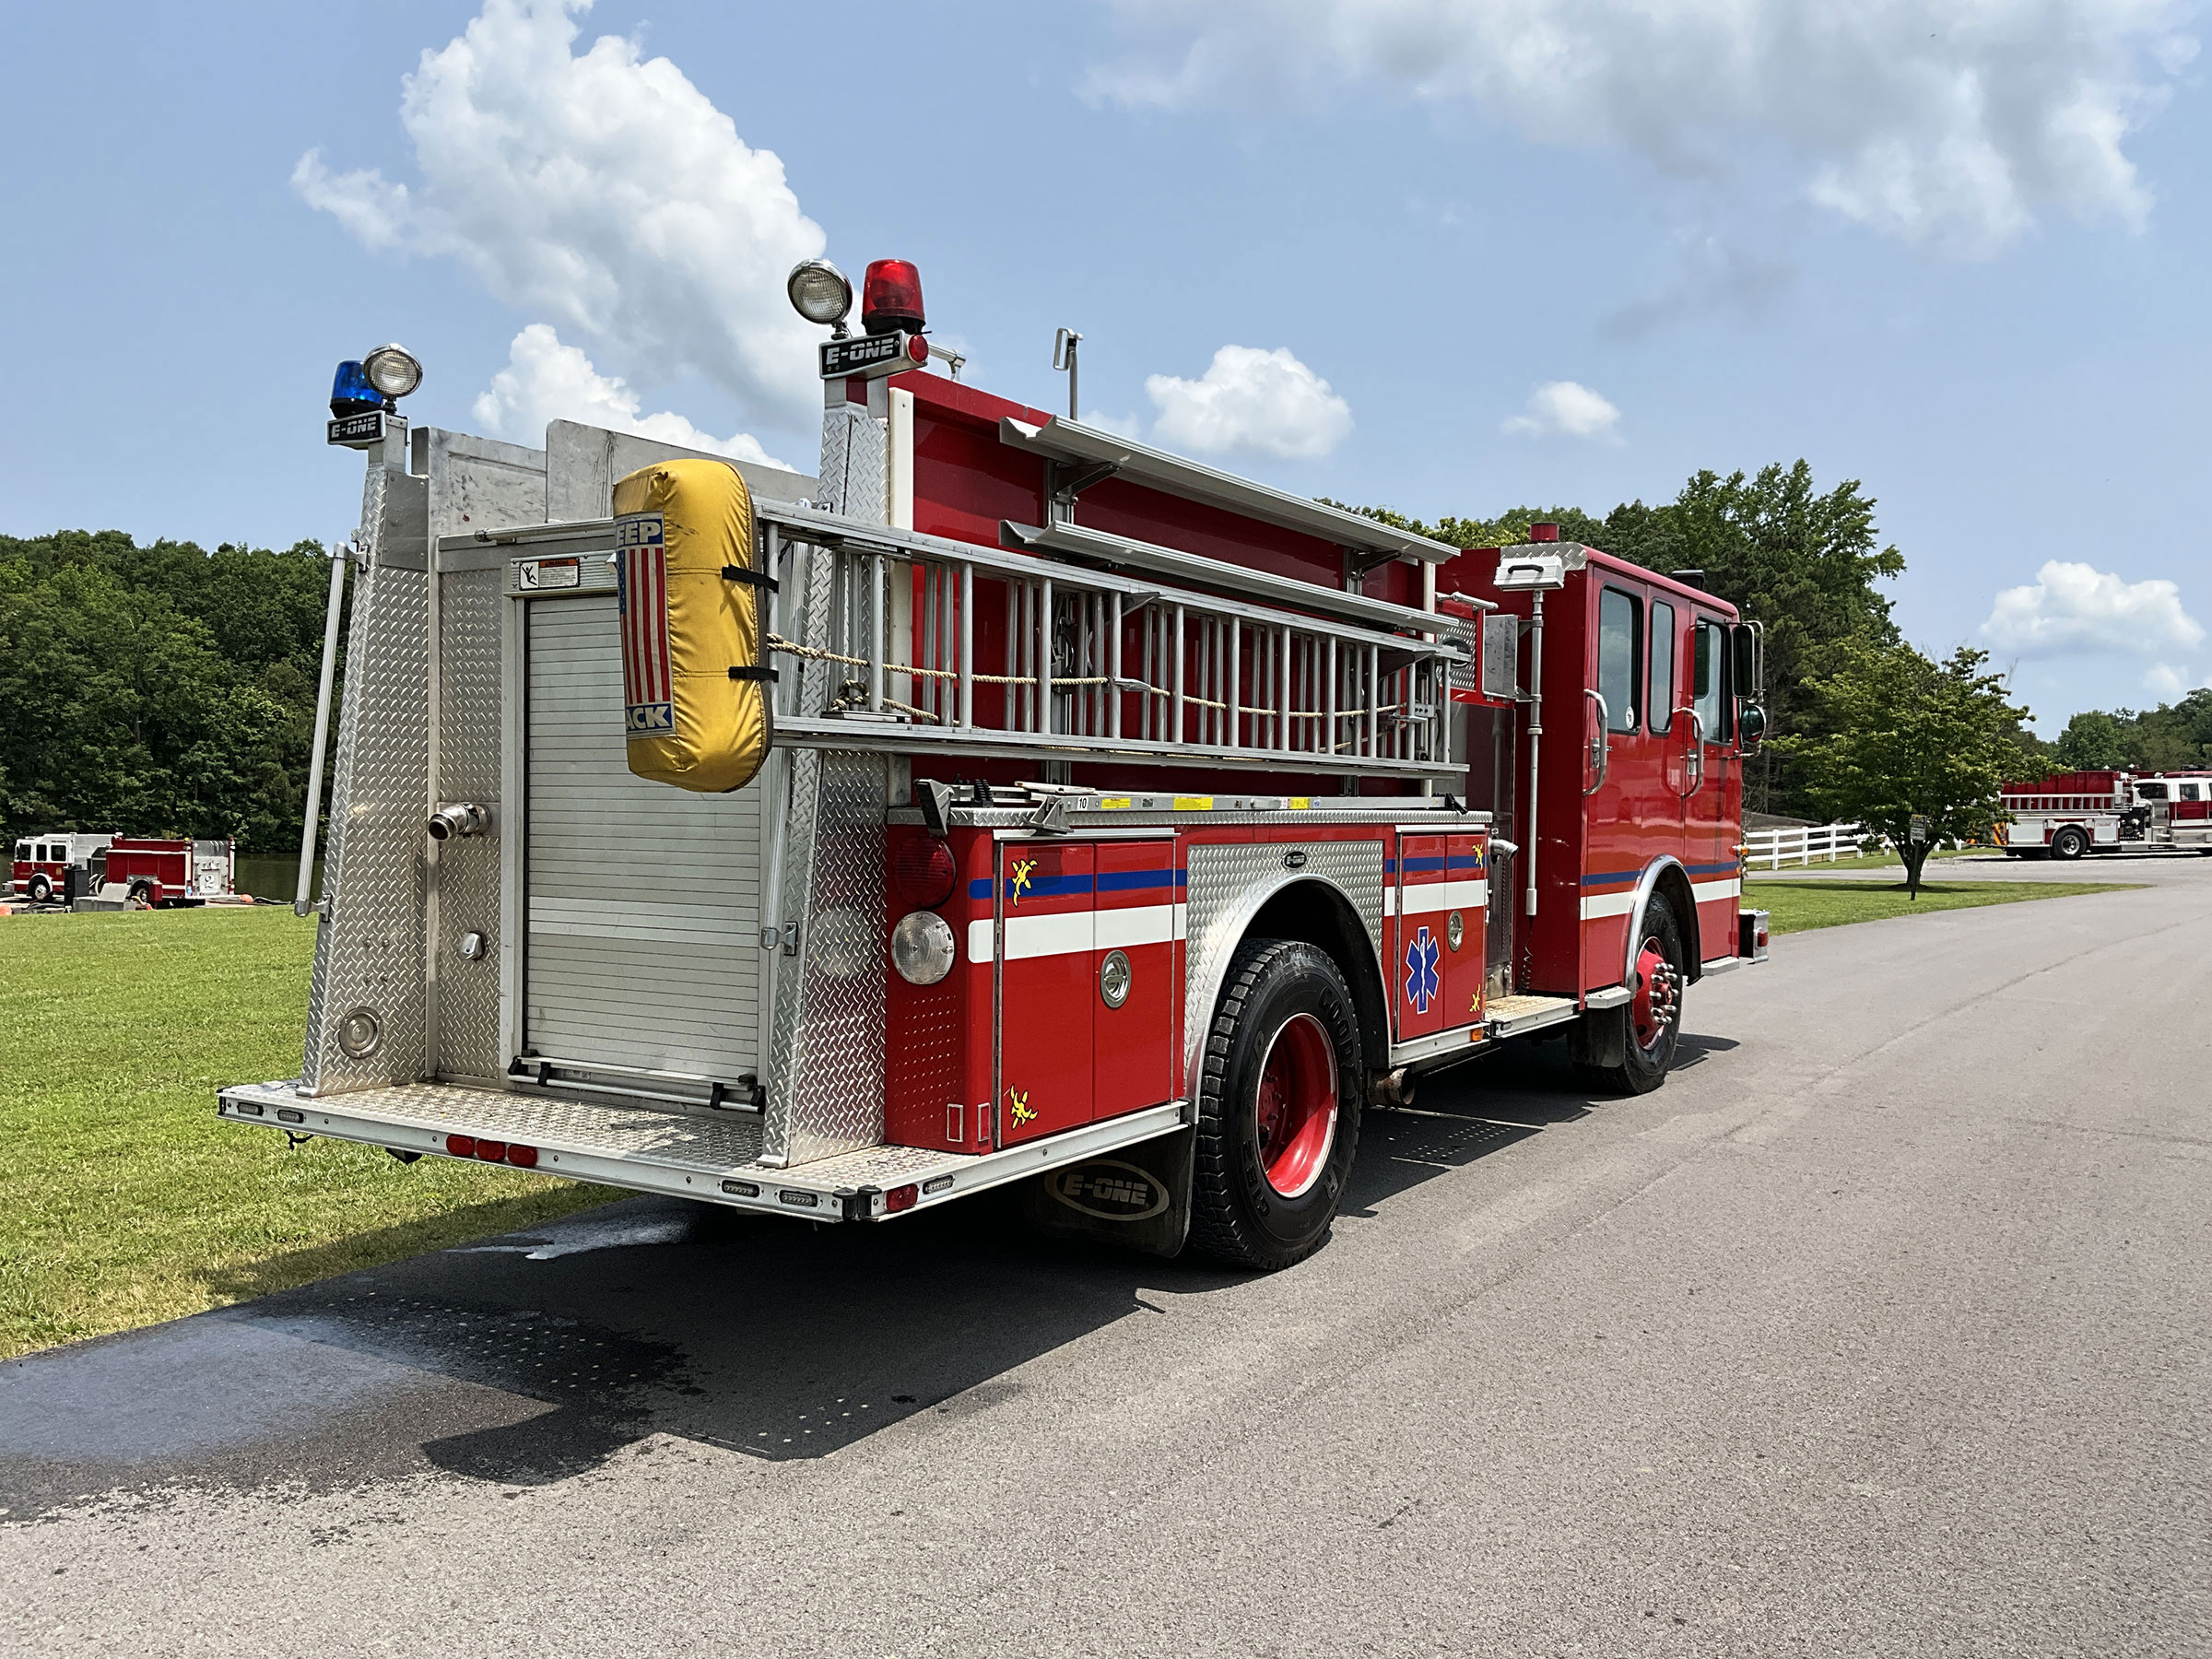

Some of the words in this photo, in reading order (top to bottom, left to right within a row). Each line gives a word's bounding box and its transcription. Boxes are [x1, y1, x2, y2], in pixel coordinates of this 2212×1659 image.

[826, 338, 894, 365] E-ONE
[331, 417, 377, 439] E-ONE
[1078, 797, 1088, 809] 10
[205, 876, 215, 889] 2
[1062, 1173, 1148, 1206] E-ONE
